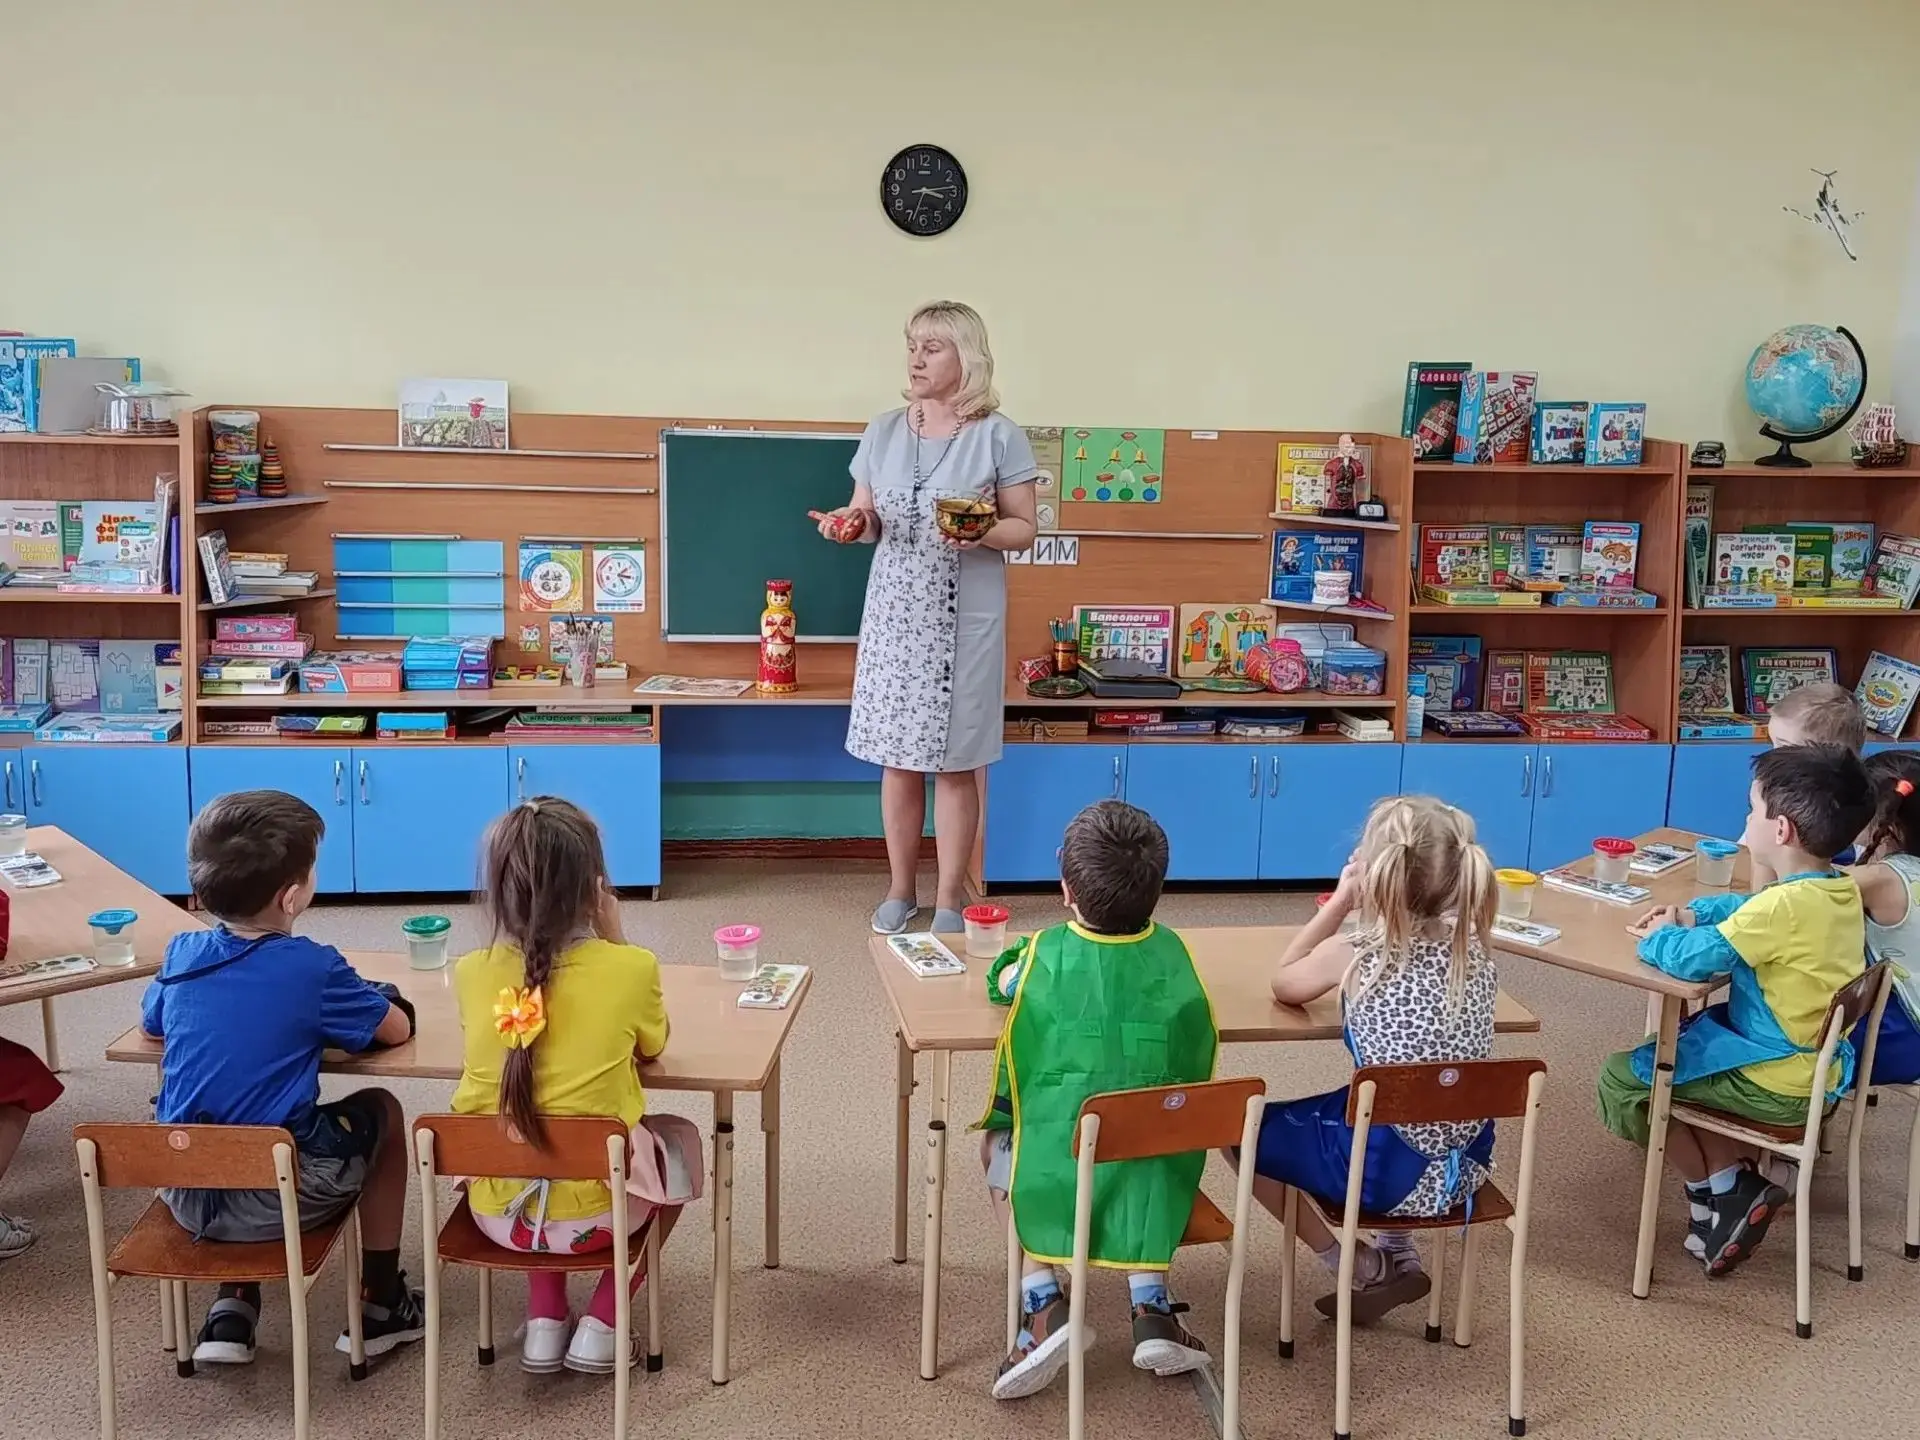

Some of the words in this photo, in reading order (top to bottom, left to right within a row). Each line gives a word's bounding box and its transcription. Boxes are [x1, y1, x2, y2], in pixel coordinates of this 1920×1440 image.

[906, 157, 915, 170] 11
[919, 155, 931, 167] 12
[893, 169, 906, 181] 10
[944, 170, 953, 182] 2
[891, 183, 900, 196] 9
[949, 185, 958, 198] 3
[895, 199, 904, 211] 8
[944, 201, 952, 212] 4
[905, 210, 914, 222] 7
[919, 214, 928, 227] 6
[933, 211, 942, 223] 5
[1090, 611, 1161, 622] Валеология
[1444, 1072, 1453, 1083] 2
[1170, 1096, 1179, 1106] 2
